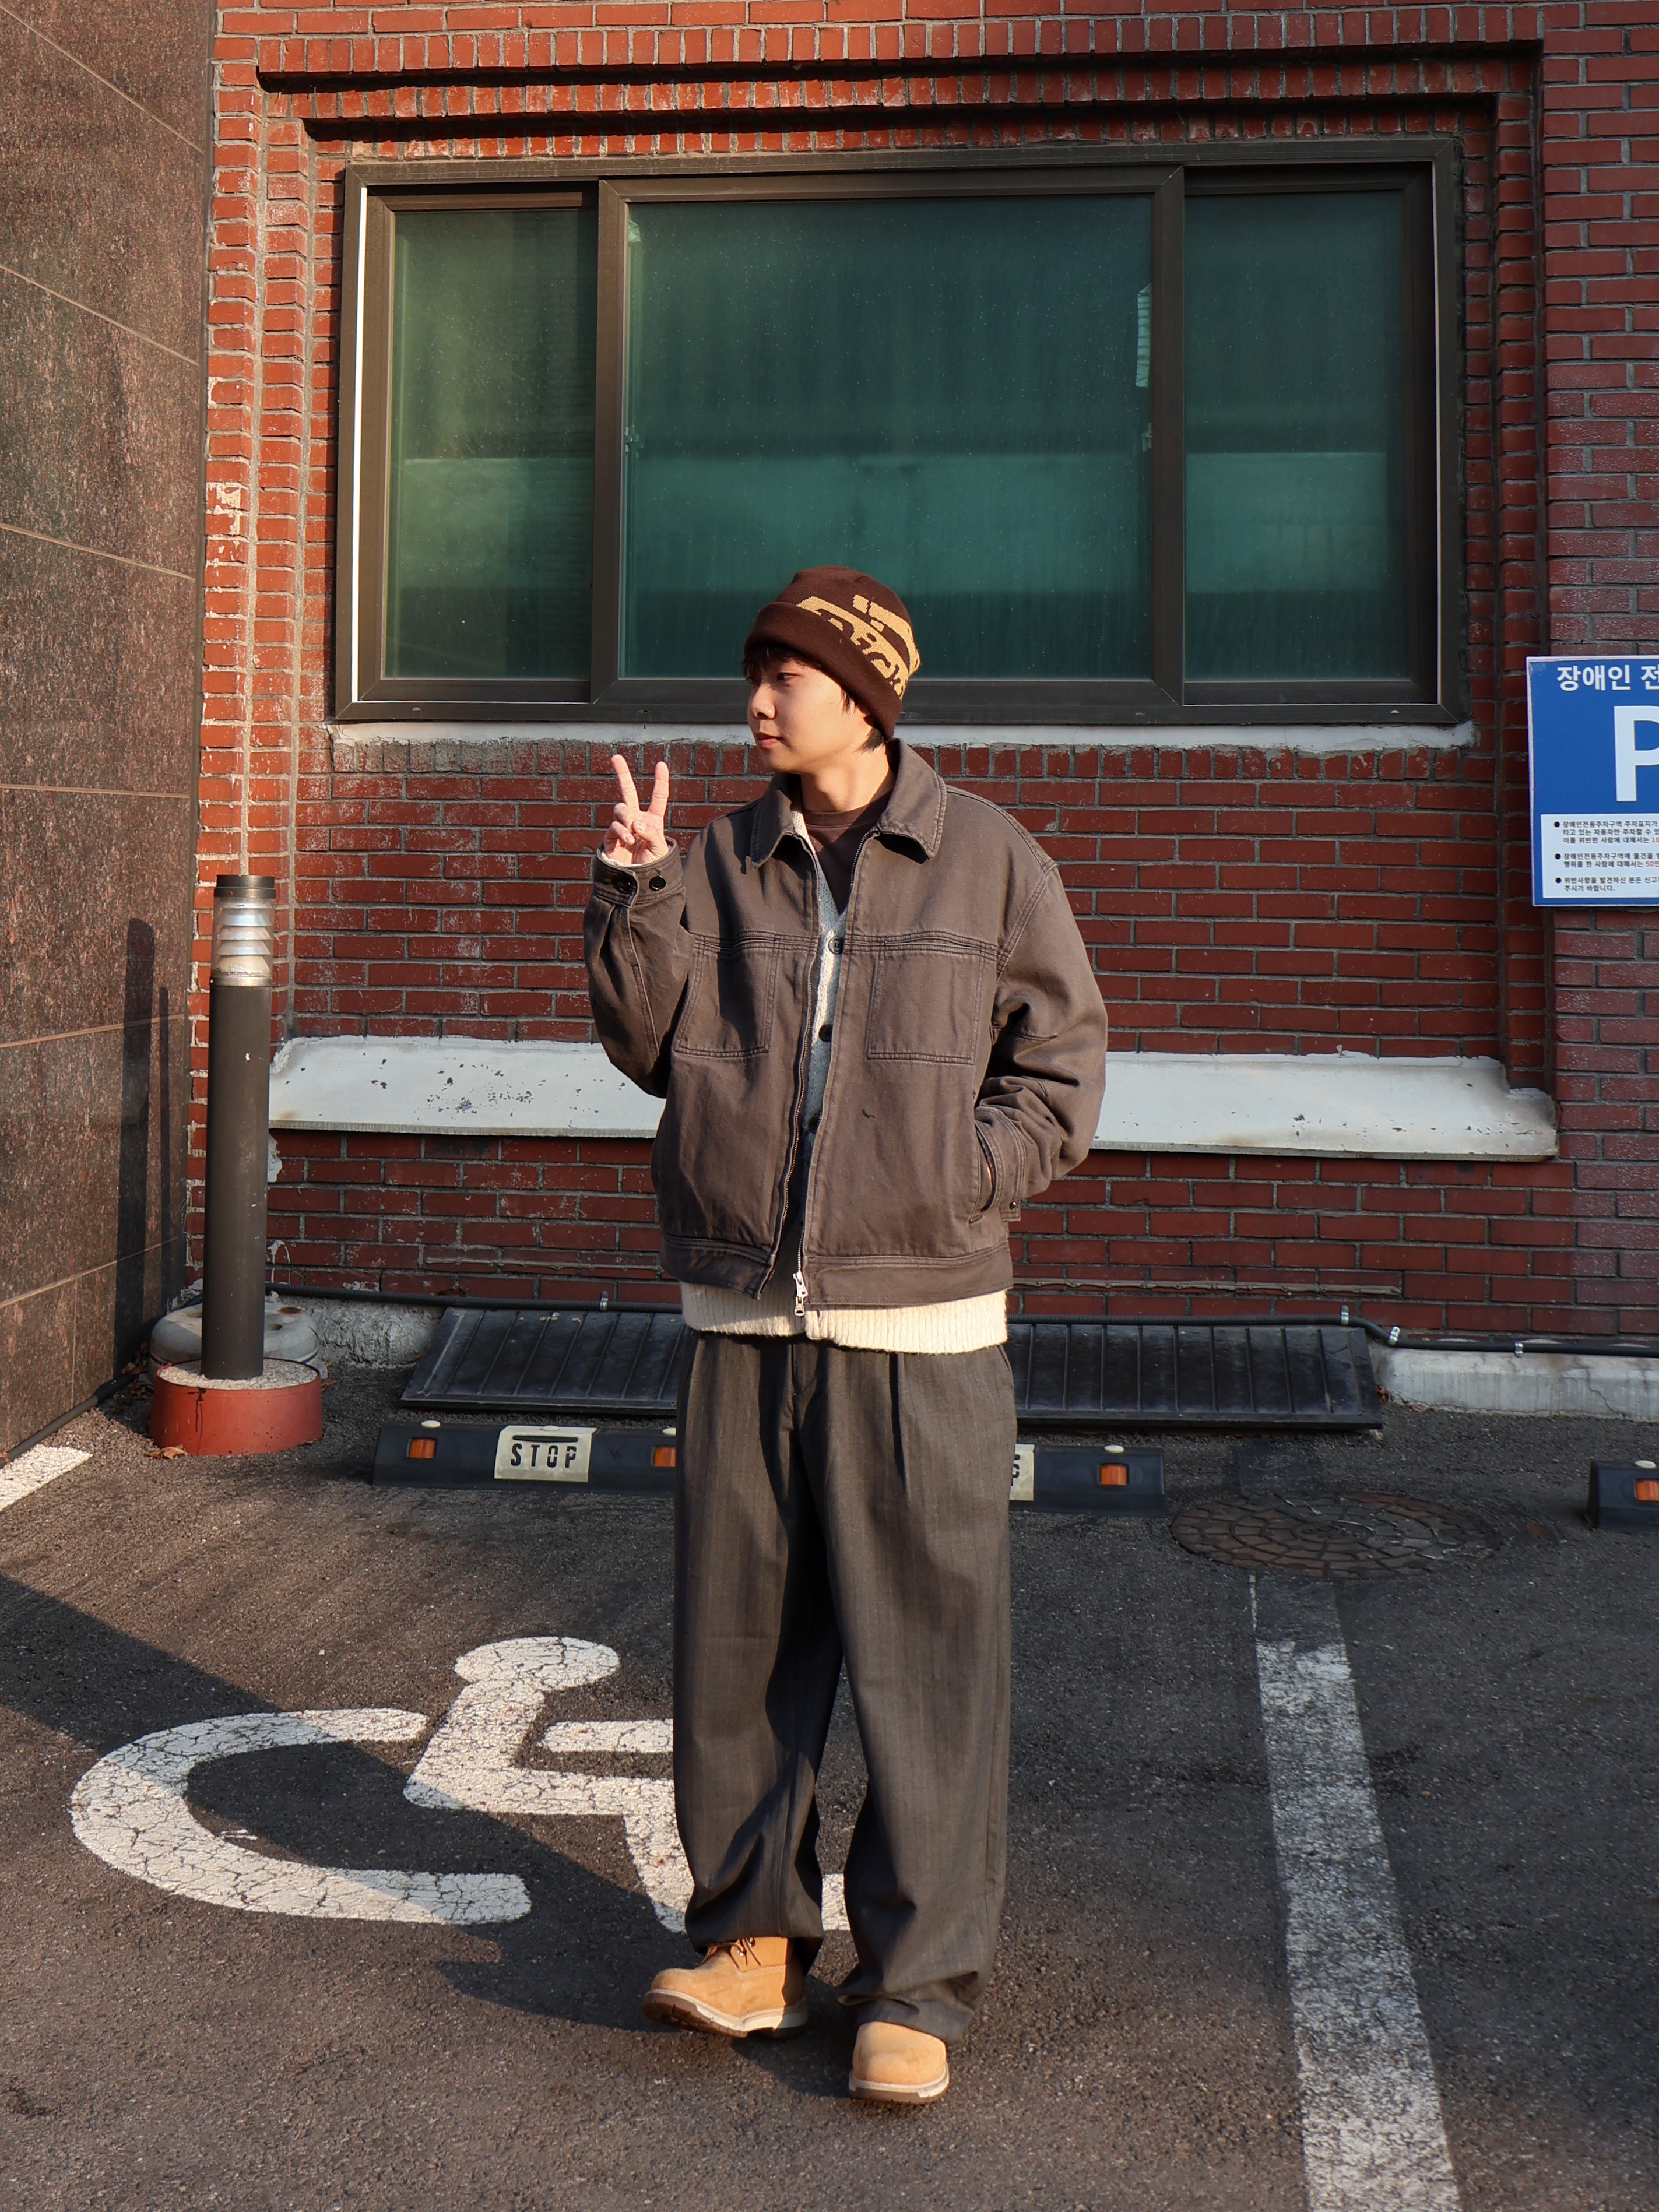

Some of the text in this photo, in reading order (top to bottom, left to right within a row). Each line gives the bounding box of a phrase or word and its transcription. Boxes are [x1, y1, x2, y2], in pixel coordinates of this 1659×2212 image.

[1556, 664, 1631, 691] 장애인
[1613, 705, 1659, 802] P
[511, 1443, 577, 1468] STOP
